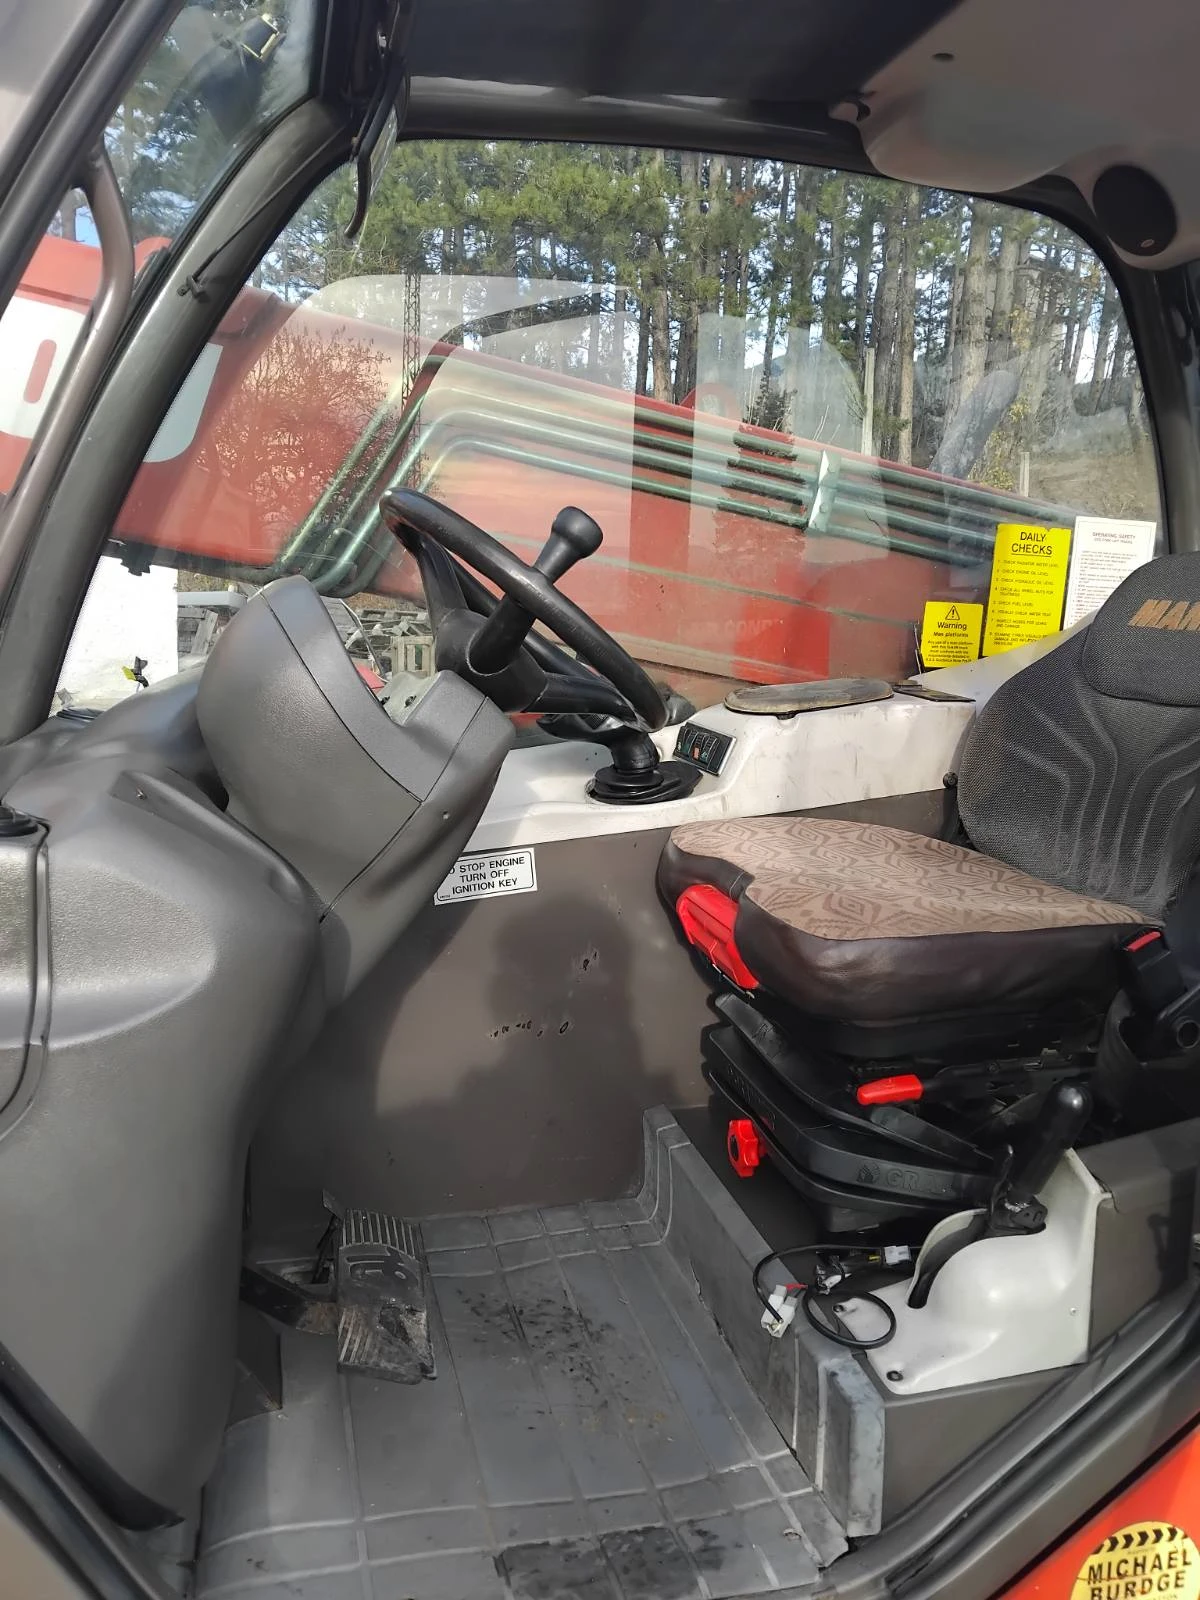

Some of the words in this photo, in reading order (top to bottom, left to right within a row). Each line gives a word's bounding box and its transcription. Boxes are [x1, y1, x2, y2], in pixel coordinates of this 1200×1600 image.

[1020, 532, 1046, 542] DAILY
[1011, 543, 1052, 555] CHECKS
[937, 622, 967, 631] Warning
[459, 862, 485, 873] STOP
[489, 856, 525, 869] ENGINE
[459, 872, 487, 883] TURN
[490, 869, 509, 879] OFF
[452, 881, 495, 895] IGNITION
[498, 877, 518, 888] KEY
[1087, 1549, 1192, 1585] MICHAEL
[1090, 1570, 1186, 1600] BURDGE
